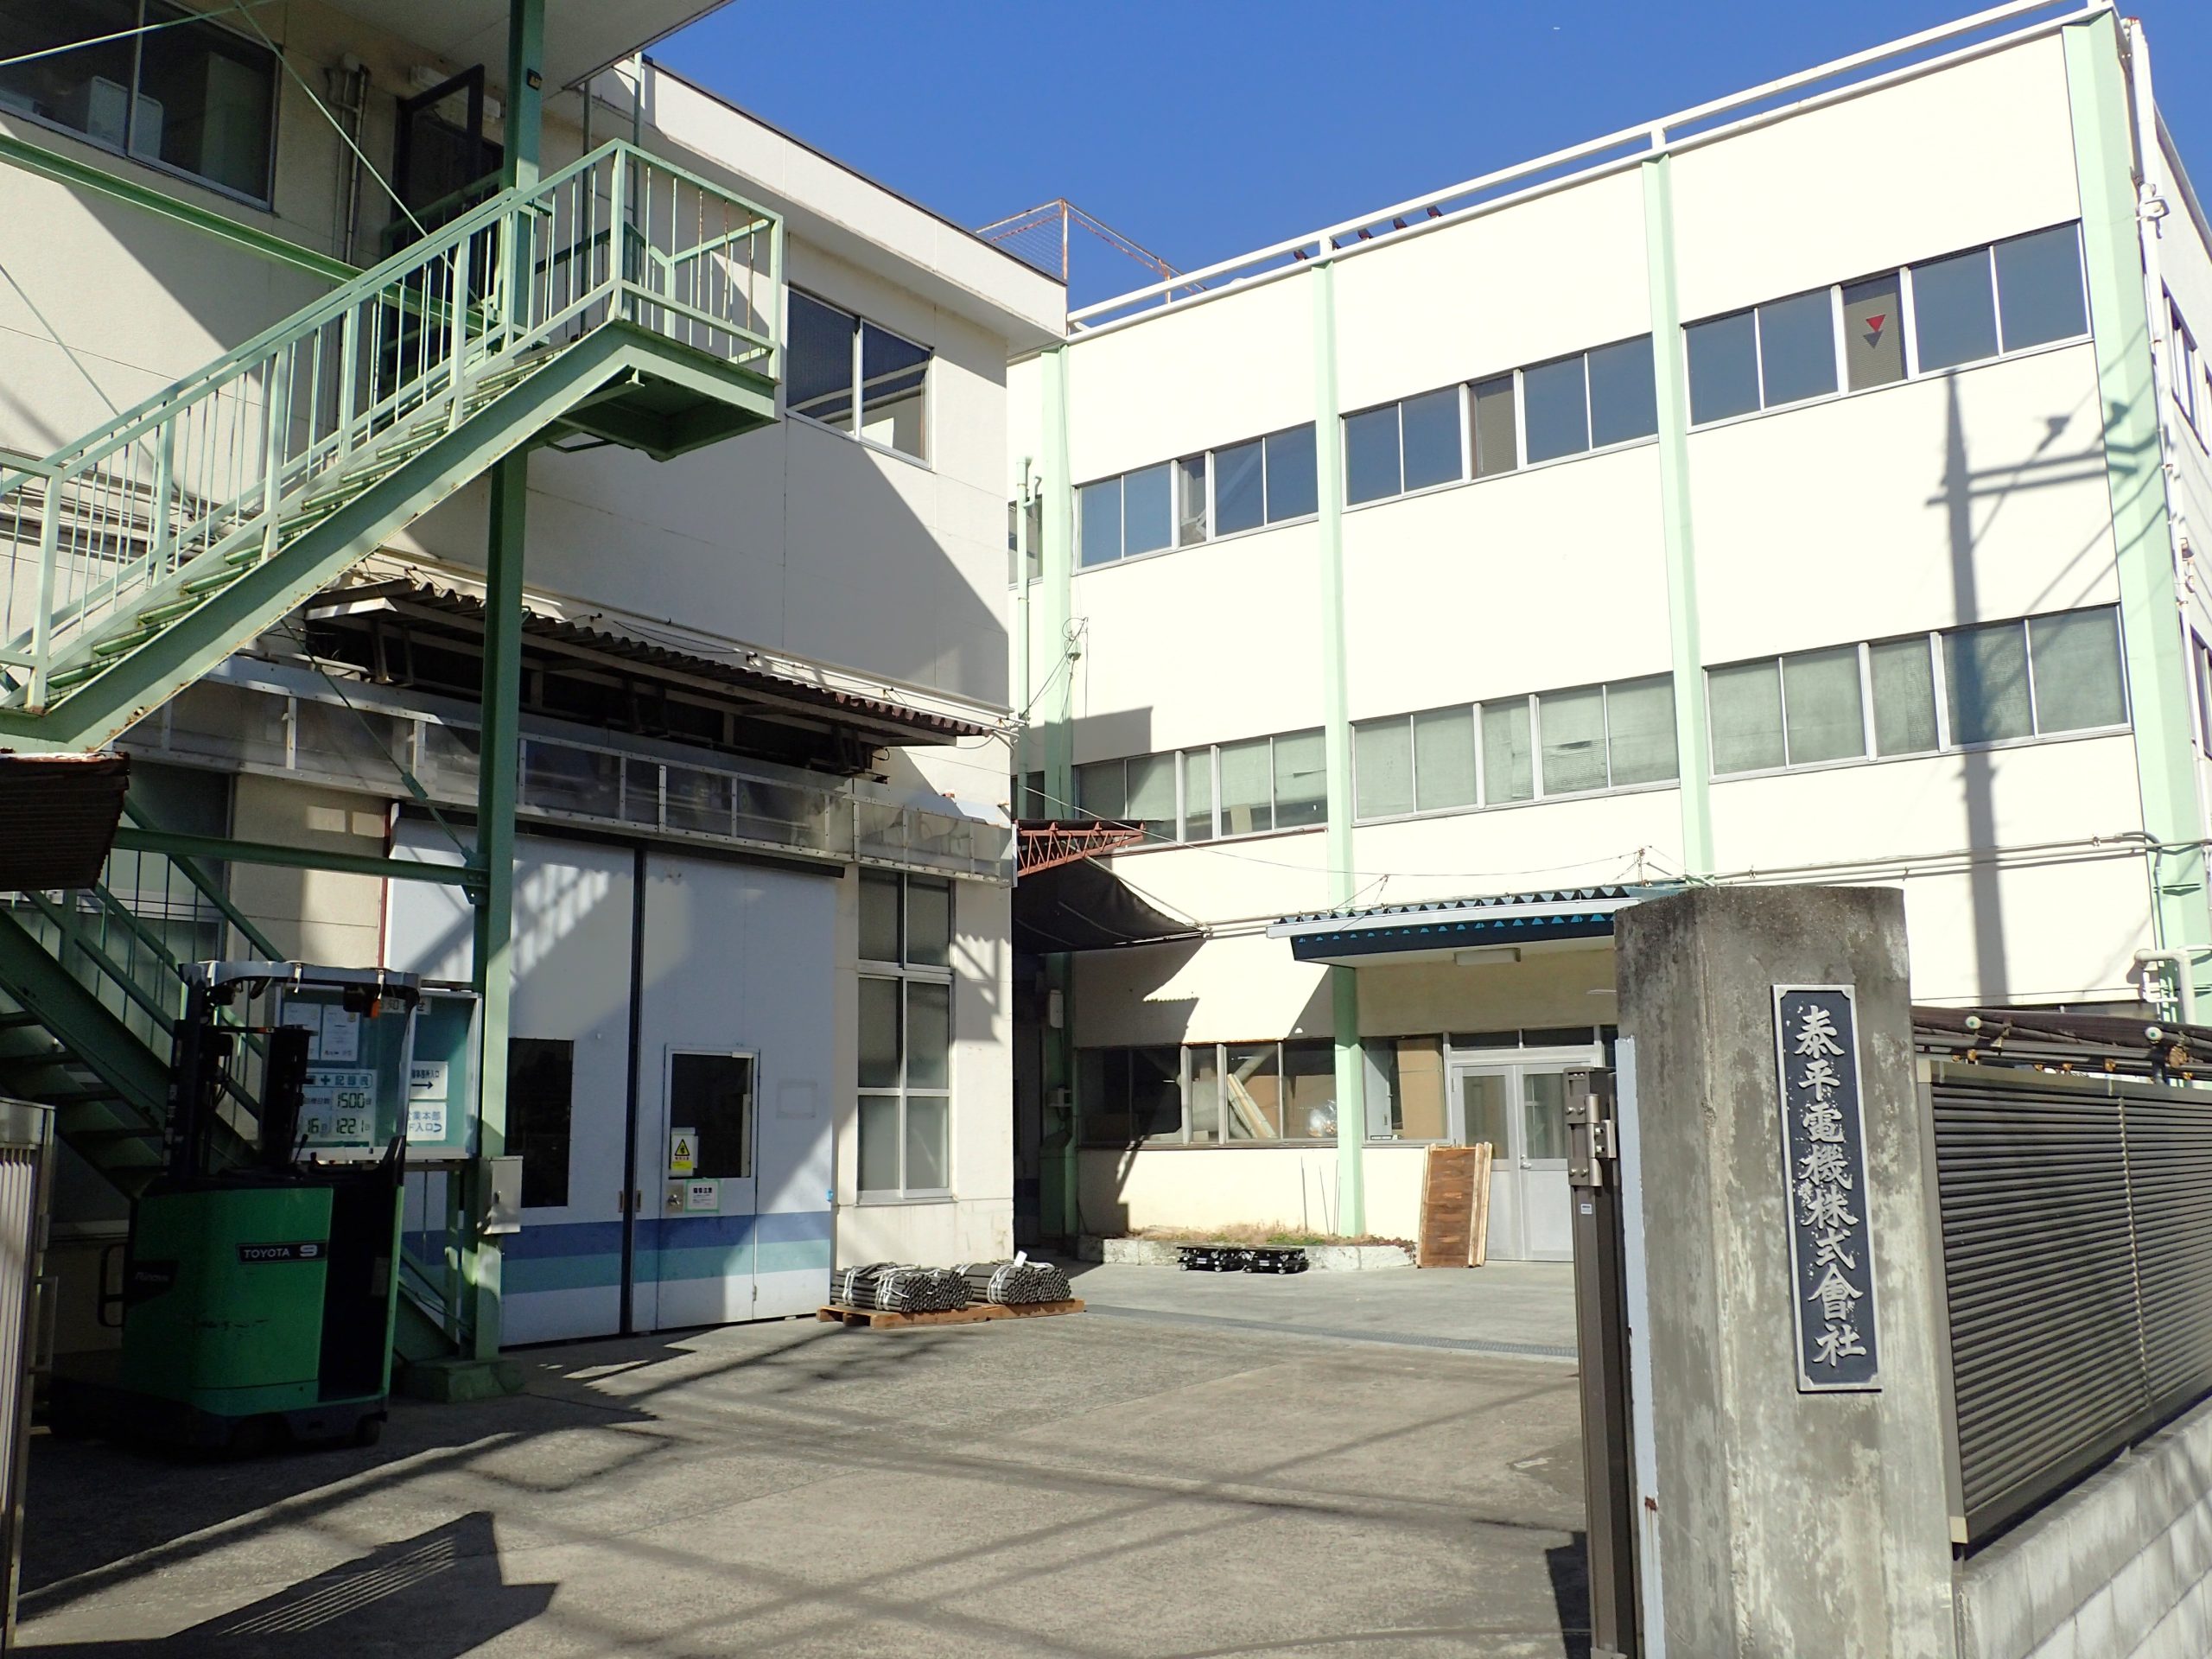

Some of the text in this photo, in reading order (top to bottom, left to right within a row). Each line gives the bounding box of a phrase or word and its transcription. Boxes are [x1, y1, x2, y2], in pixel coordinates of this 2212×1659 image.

[244, 1248, 290, 1259] TOYOTA
[1794, 1005, 1867, 1367] 泰平電機株式會社
